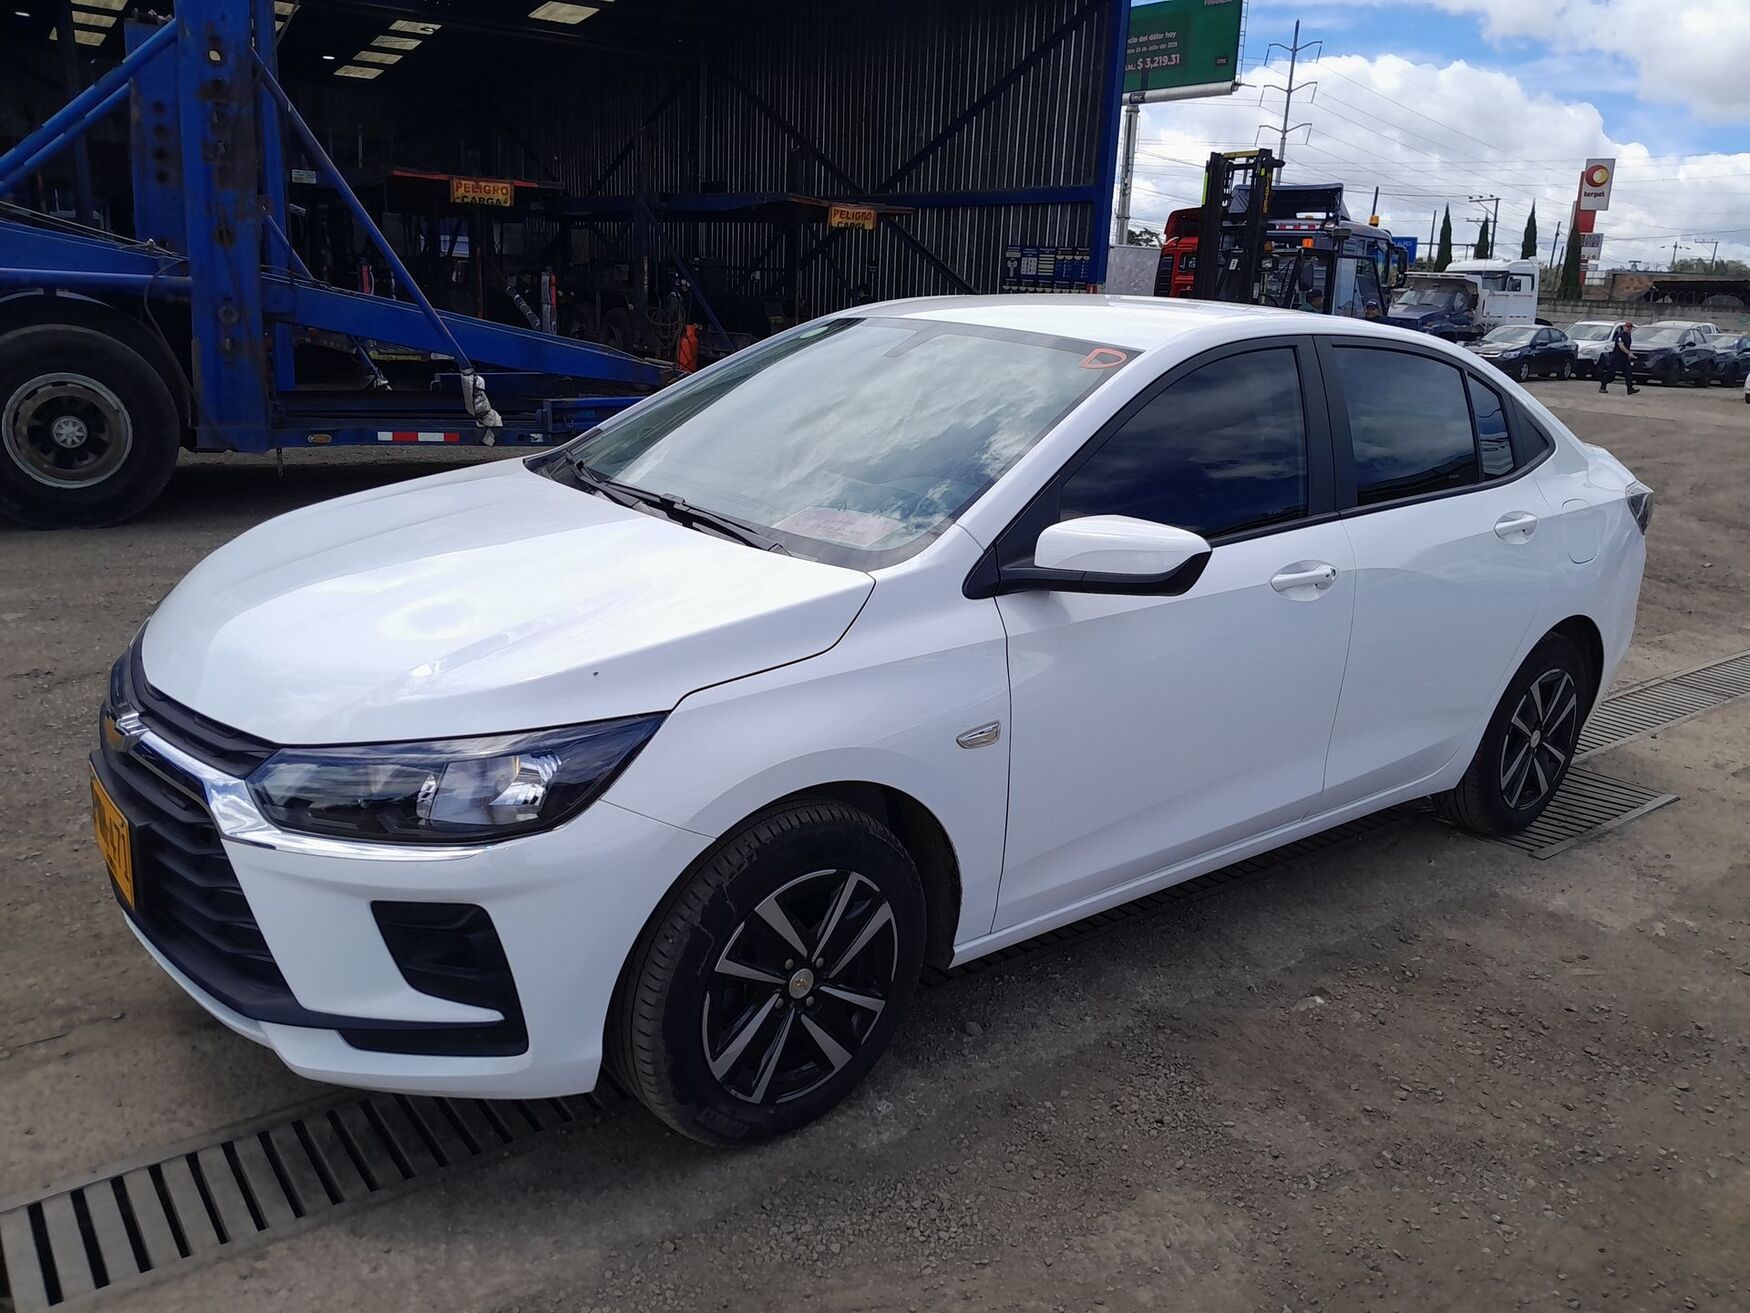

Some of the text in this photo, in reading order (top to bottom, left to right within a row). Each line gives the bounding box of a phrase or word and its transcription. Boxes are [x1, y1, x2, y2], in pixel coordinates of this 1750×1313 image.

[1136, 57, 1144, 71] $
[1145, 54, 1180, 69] 3,219.31
[455, 181, 509, 196] PELIGRO
[1583, 190, 1605, 198] terpel
[462, 195, 502, 206] CARGA
[833, 208, 873, 221] PELIGRO
[837, 221, 866, 229] CARGA
